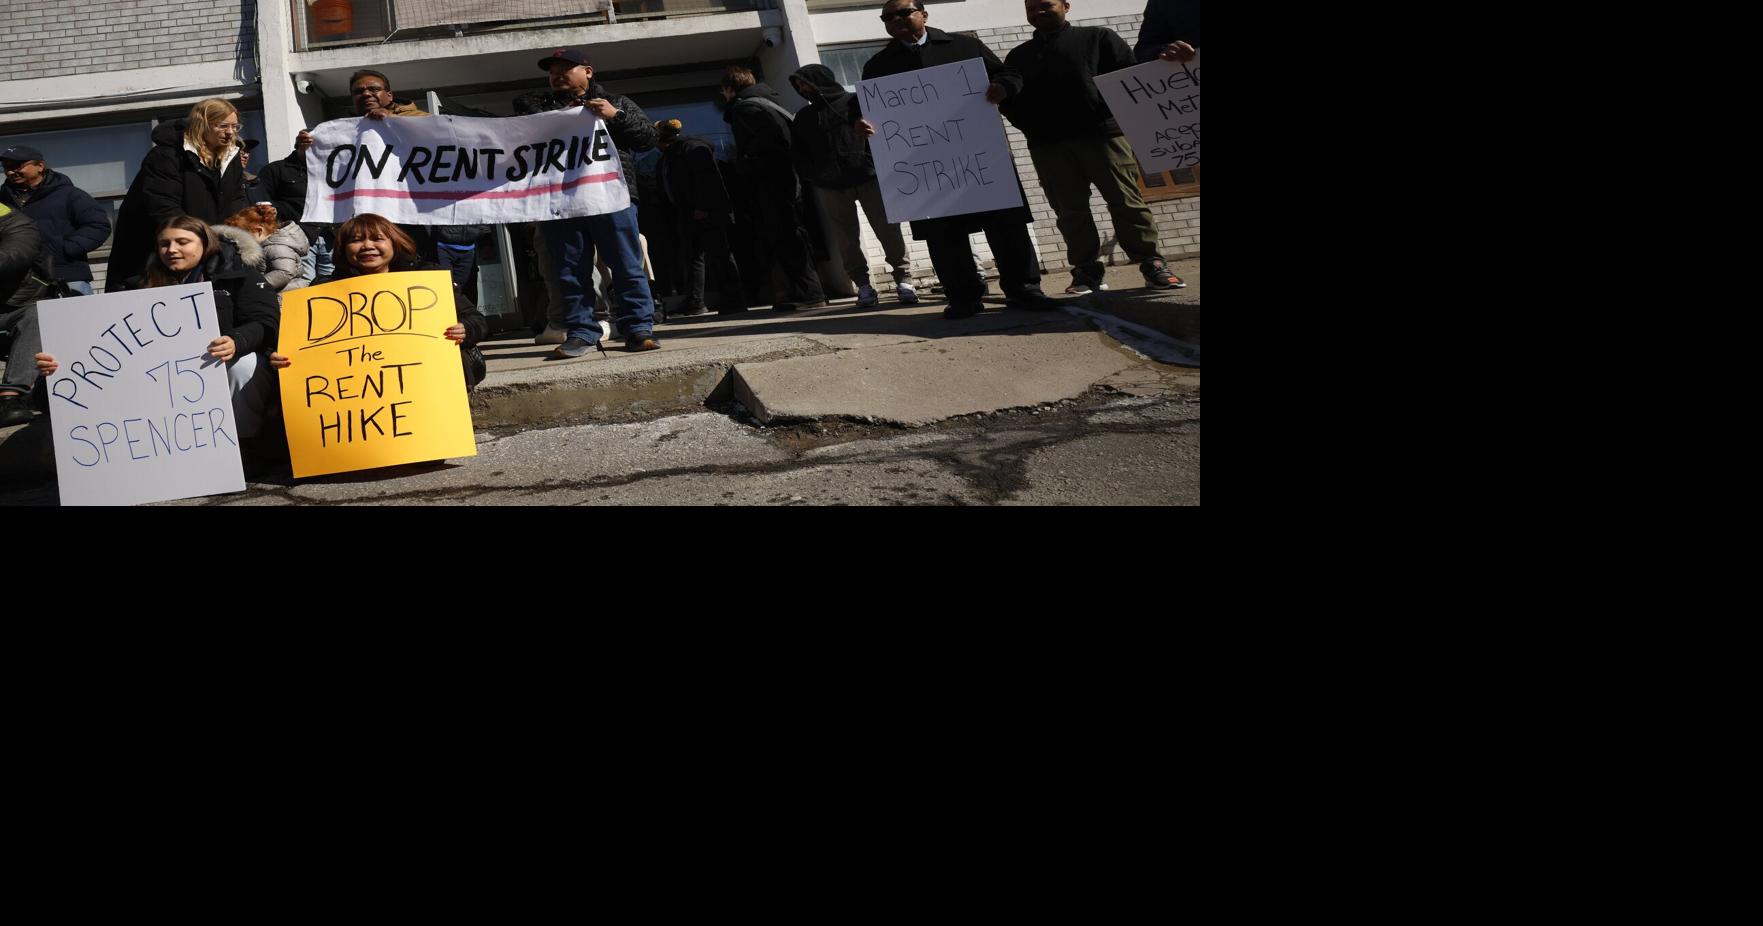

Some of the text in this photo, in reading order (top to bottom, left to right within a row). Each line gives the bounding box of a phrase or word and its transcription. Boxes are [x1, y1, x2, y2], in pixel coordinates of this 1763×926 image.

[861, 65, 985, 112] March 1
[881, 118, 965, 150] RENT
[325, 129, 611, 188] ON RENT STRIKE
[893, 151, 994, 195] STRIKE
[1171, 151, 1200, 168] 75
[307, 286, 438, 343] DROP
[52, 292, 205, 409] PROTECT
[336, 344, 384, 367] The
[145, 355, 205, 408] 75
[305, 362, 423, 408] RENT
[69, 407, 237, 467] SPENCER
[319, 400, 413, 448] HIKE
